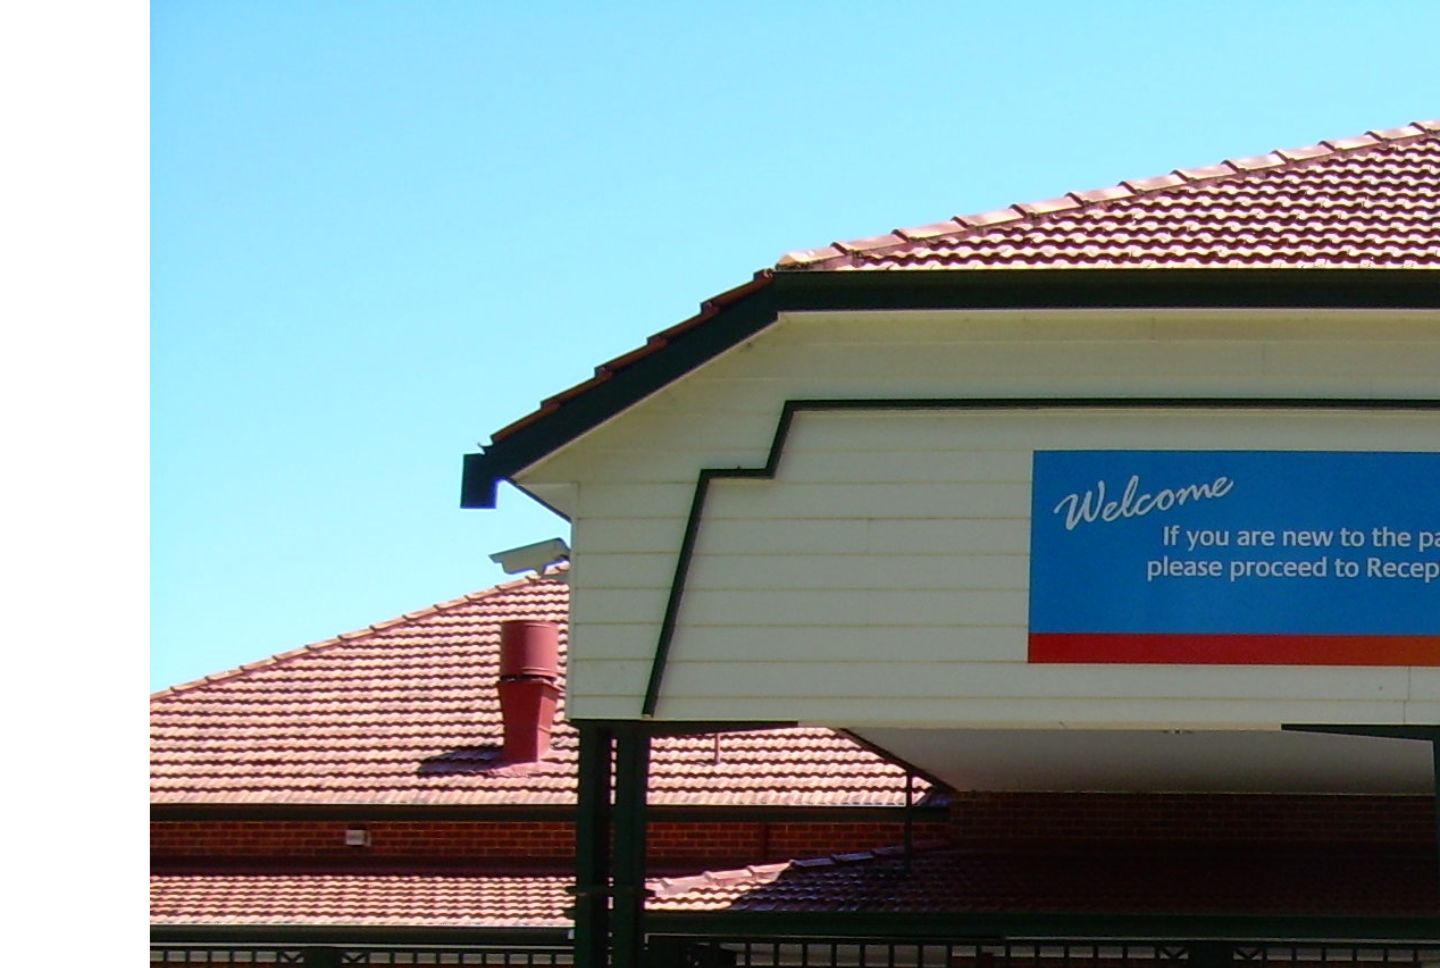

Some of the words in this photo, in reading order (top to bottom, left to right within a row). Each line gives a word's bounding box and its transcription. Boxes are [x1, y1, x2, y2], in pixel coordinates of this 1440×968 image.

[1054, 475, 1234, 530] Welcome
[1163, 525, 1180, 547] If
[1187, 530, 1229, 550] you
[1237, 530, 1275, 547] are
[1282, 530, 1333, 547] new
[1341, 528, 1366, 548] to
[1372, 526, 1412, 548] the
[1147, 556, 1223, 581] please
[1230, 557, 1328, 583] proceed
[1335, 559, 1360, 579] to
